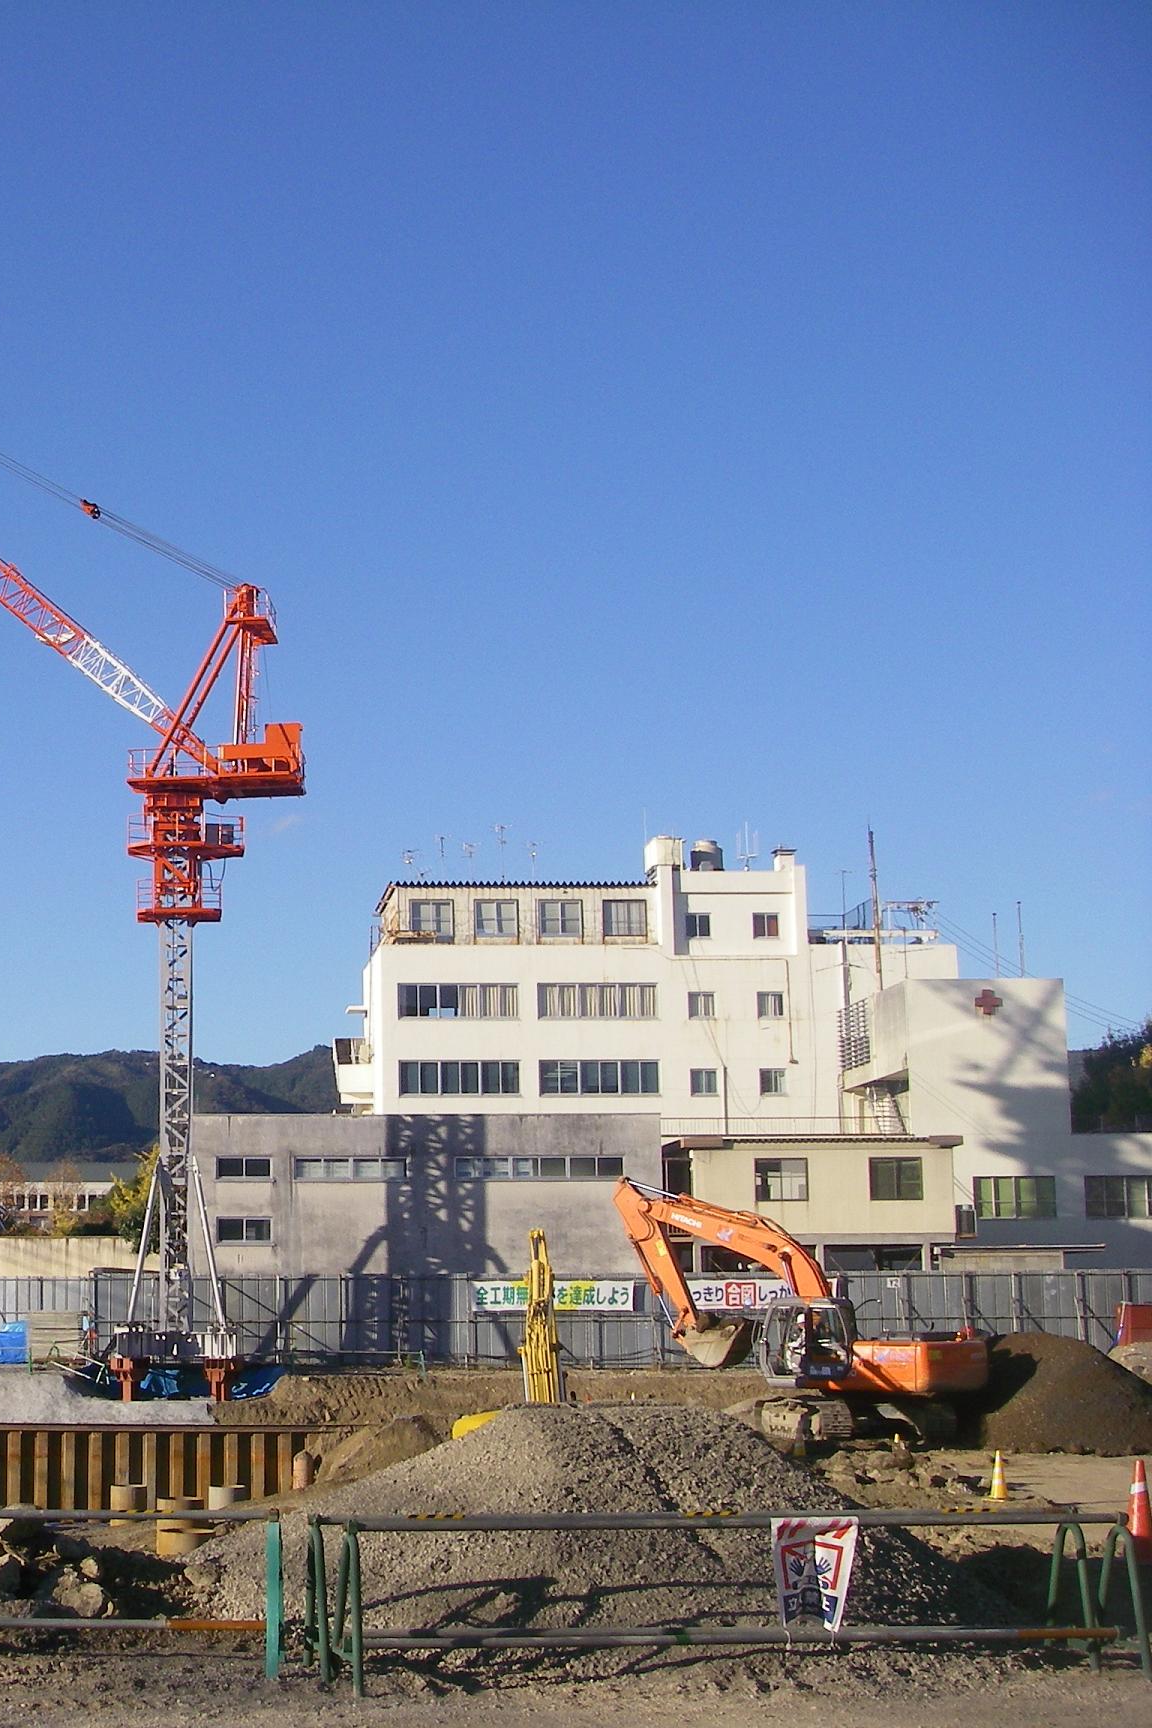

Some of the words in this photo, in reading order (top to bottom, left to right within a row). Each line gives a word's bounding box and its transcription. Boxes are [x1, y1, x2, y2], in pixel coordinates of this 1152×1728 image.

[671, 1212, 703, 1228] HITACHI
[476, 1286, 630, 1305] 全工期無を達成しよう
